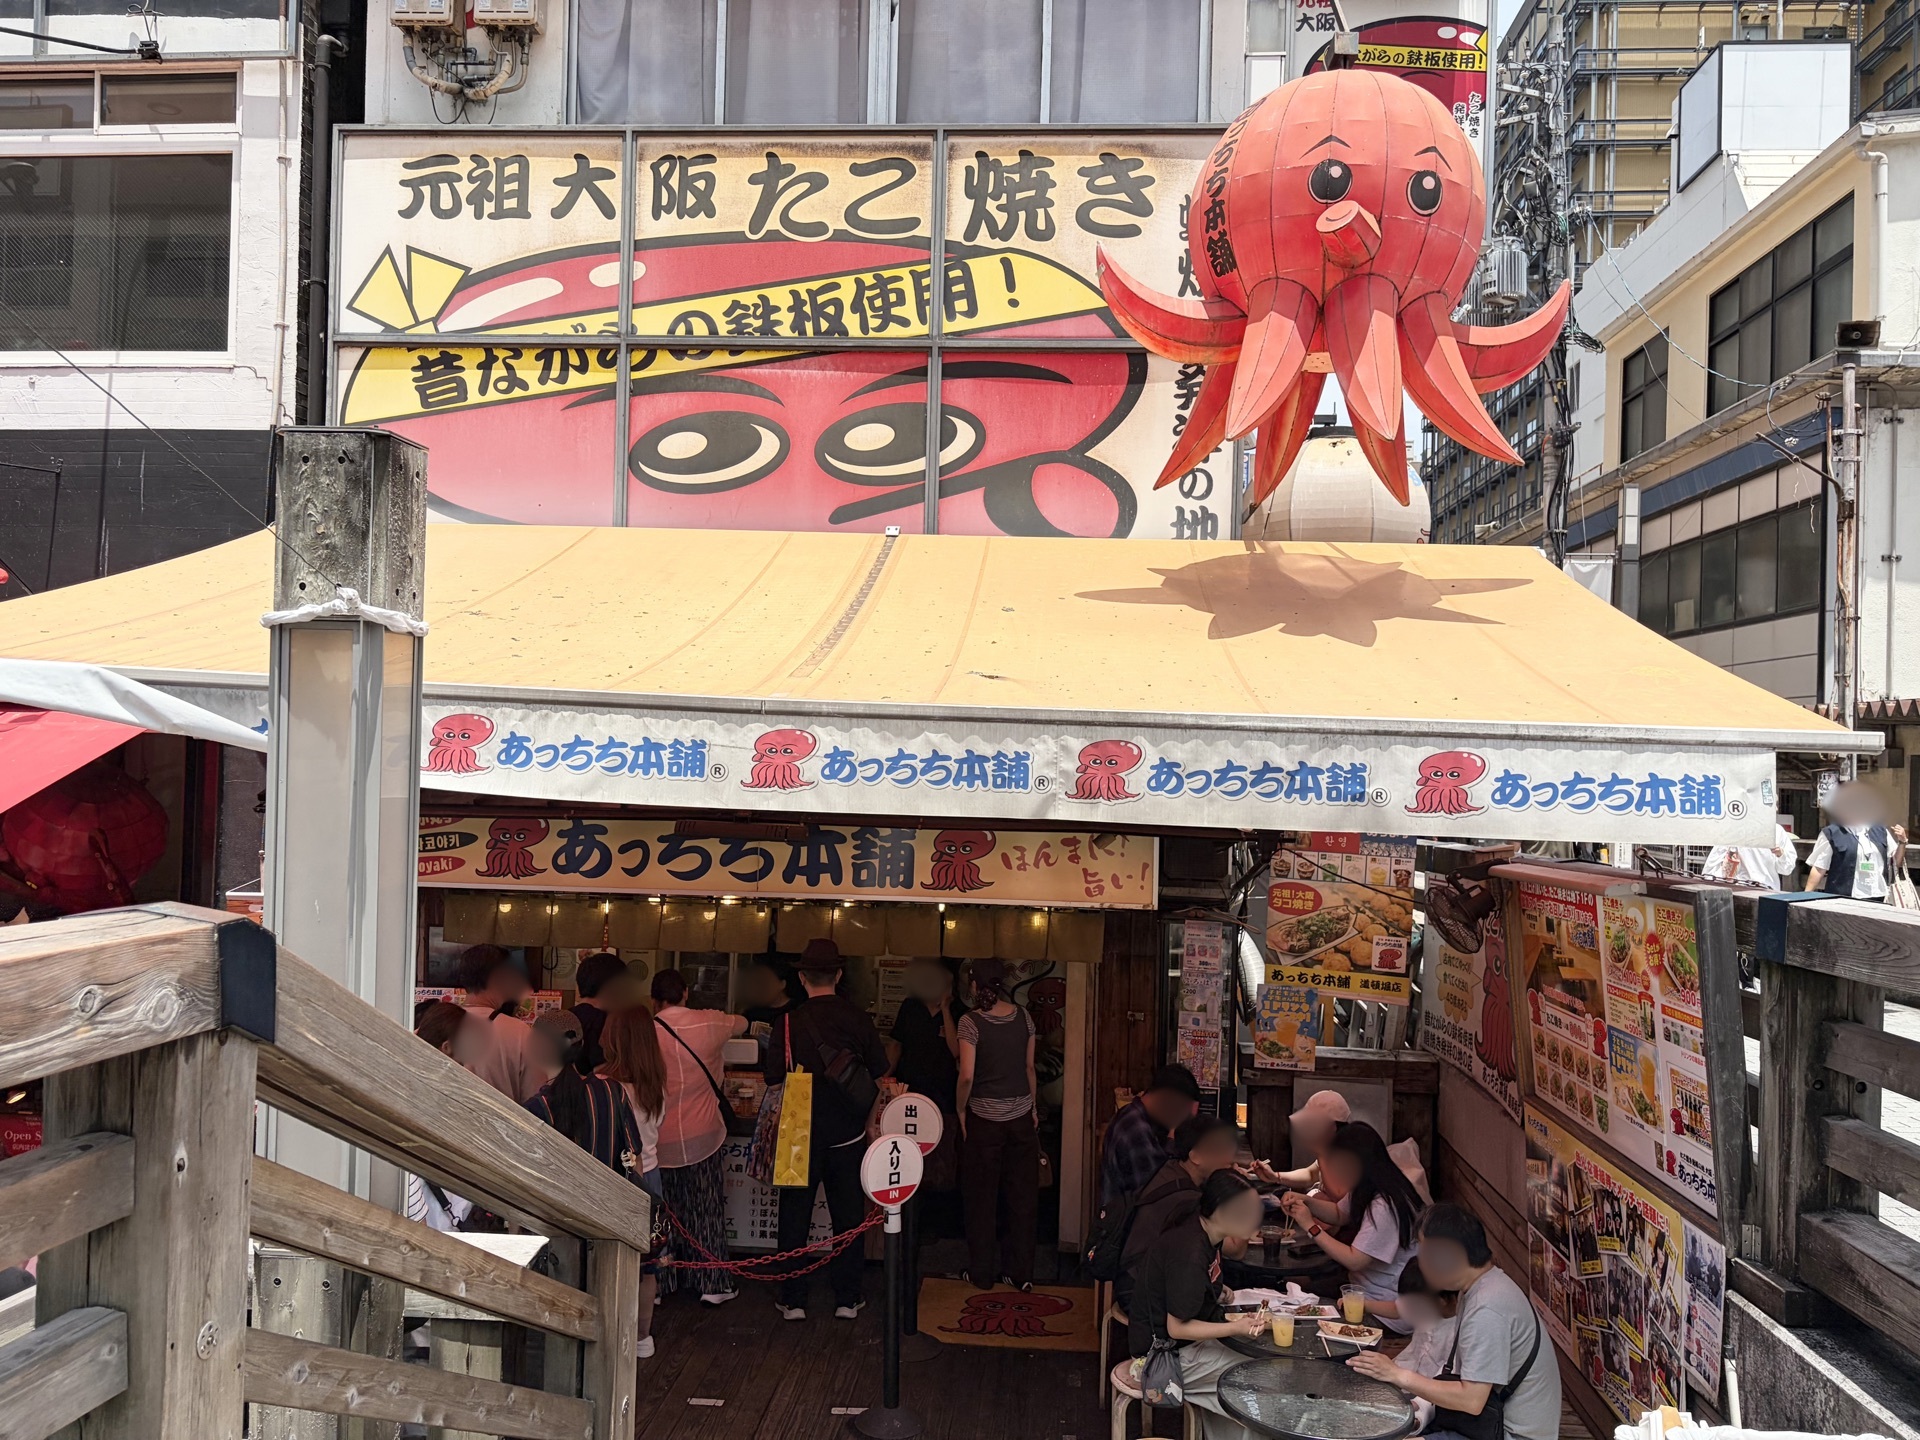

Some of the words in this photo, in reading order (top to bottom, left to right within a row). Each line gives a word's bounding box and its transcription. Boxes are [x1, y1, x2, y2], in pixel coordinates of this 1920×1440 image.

[1295, 13, 1336, 32] 大阪
[1469, 93, 1480, 138] たこ焼き
[552, 818, 917, 889] あっちち本舗
[1271, 969, 1351, 990] あっちち本舗
[1359, 978, 1402, 993] 道頓堀店
[905, 1104, 918, 1136] 出口
[4, 1130, 32, 1142] Open
[889, 1141, 901, 1186] 入り口
[889, 1190, 899, 1199] IN
